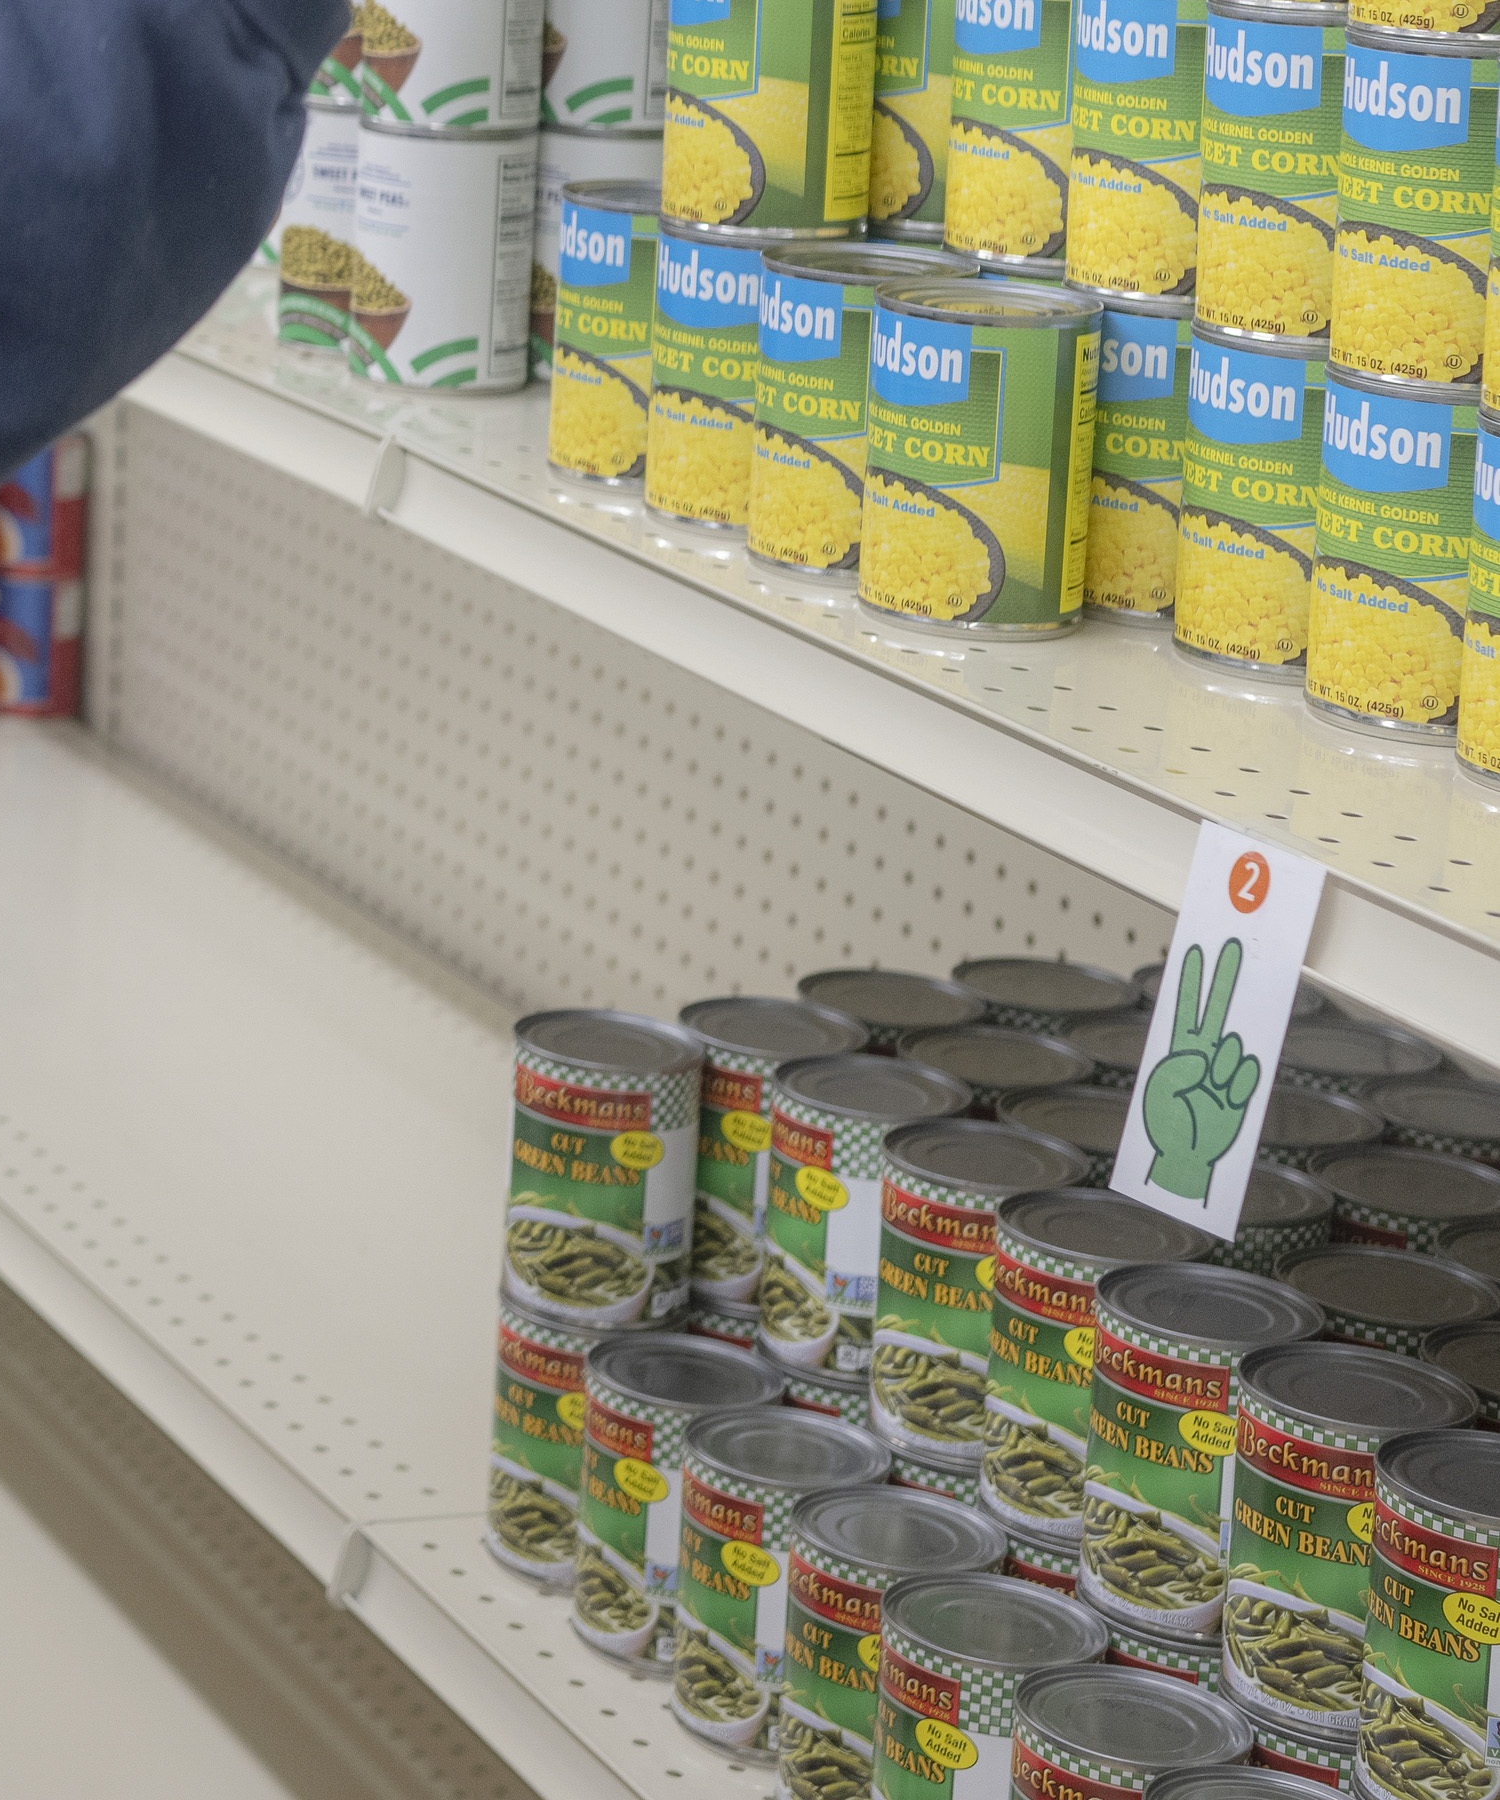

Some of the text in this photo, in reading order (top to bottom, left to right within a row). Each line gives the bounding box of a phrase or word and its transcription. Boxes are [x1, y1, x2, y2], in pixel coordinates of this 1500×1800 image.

[1399, 12, 1434, 28] (425g)
[682, 55, 749, 81] CORN
[1206, 27, 1314, 90] Hudson
[981, 86, 1061, 111] CORN
[1116, 94, 1167, 111] GOLDEN
[1343, 56, 1461, 124] Hudson
[1111, 114, 1196, 142] CORN
[1219, 121, 1313, 145] KERNEL GOLDEN
[1251, 153, 1339, 177] CORN
[1358, 157, 1460, 182] KERNEL GOLDEN
[1099, 179, 1142, 194] Added
[1393, 187, 1491, 215] CORN
[1213, 208, 1287, 232] Salt Added
[1350, 248, 1430, 272] Salt Added
[658, 242, 758, 306] Hudson
[759, 281, 835, 341] udson
[578, 312, 648, 342] CORN
[1251, 318, 1286, 334] (425g)
[1391, 361, 1428, 378] (425g)
[1190, 348, 1296, 422] Hudson
[782, 390, 861, 422] CORN
[911, 416, 961, 436] GOLDEN
[1113, 414, 1166, 432] GOLDEN
[1324, 390, 1441, 469] Hudson
[904, 437, 990, 469] CORN
[1239, 455, 1293, 477] GOLDEN
[1231, 476, 1318, 508] CORN
[893, 499, 935, 518] Added
[1339, 492, 1439, 526] KERNEL GOLDEN
[1373, 526, 1469, 560] CORN
[1330, 581, 1408, 614] Salt Added
[1367, 698, 1404, 718] (425g)
[1238, 862, 1260, 902] 2
[914, 1253, 949, 1277] CUT
[1009, 1318, 1039, 1344] CUT
[1025, 1350, 1092, 1388] BEANS
[1116, 1401, 1150, 1429] CUT
[1194, 1415, 1209, 1428] No
[1192, 1430, 1231, 1450] Added
[1239, 1413, 1374, 1487] Beckman
[1135, 1435, 1213, 1473] BEANS
[1320, 1482, 1358, 1497] SINCE
[1235, 1497, 1291, 1548] GREEN
[1275, 1496, 1314, 1524] CUT
[1385, 1576, 1414, 1606] CUT
[1418, 1565, 1486, 1592] SINCE 1928
[1458, 1597, 1475, 1613] No
[803, 1622, 832, 1649] CUT
[1399, 1616, 1480, 1663] BEANS
[1456, 1613, 1498, 1639] Added
[927, 1723, 967, 1751] No Salt
[885, 1738, 945, 1784] BEANS
[926, 1739, 961, 1764] Added
